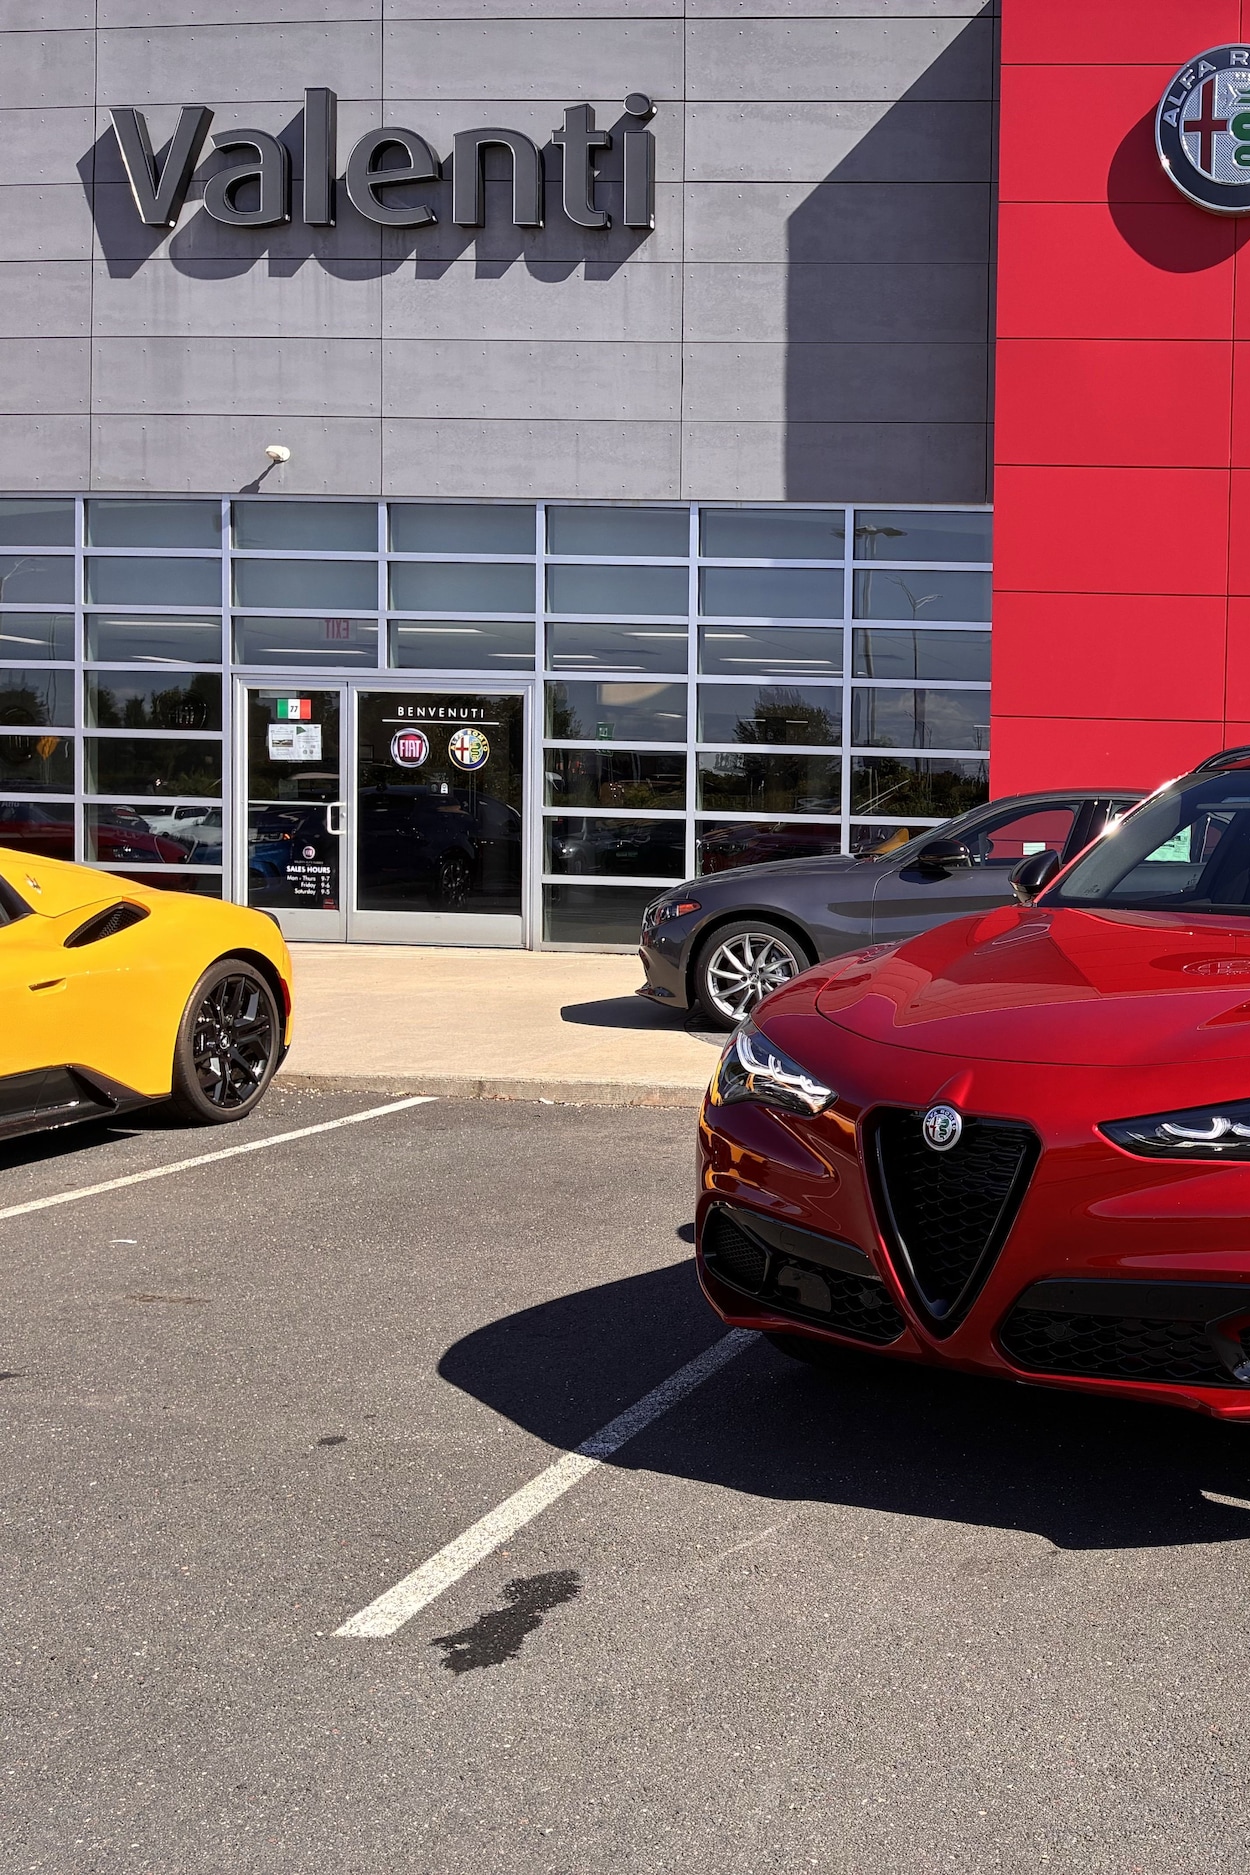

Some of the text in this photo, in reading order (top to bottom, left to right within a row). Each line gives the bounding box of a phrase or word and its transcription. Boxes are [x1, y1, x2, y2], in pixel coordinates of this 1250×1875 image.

[1163, 59, 1216, 128] ALFA
[109, 87, 657, 229] Valenti
[397, 706, 485, 718] BENVENUTI
[399, 739, 421, 758] FIAT
[286, 865, 331, 874] SALES HOURS
[300, 881, 317, 889] Friday
